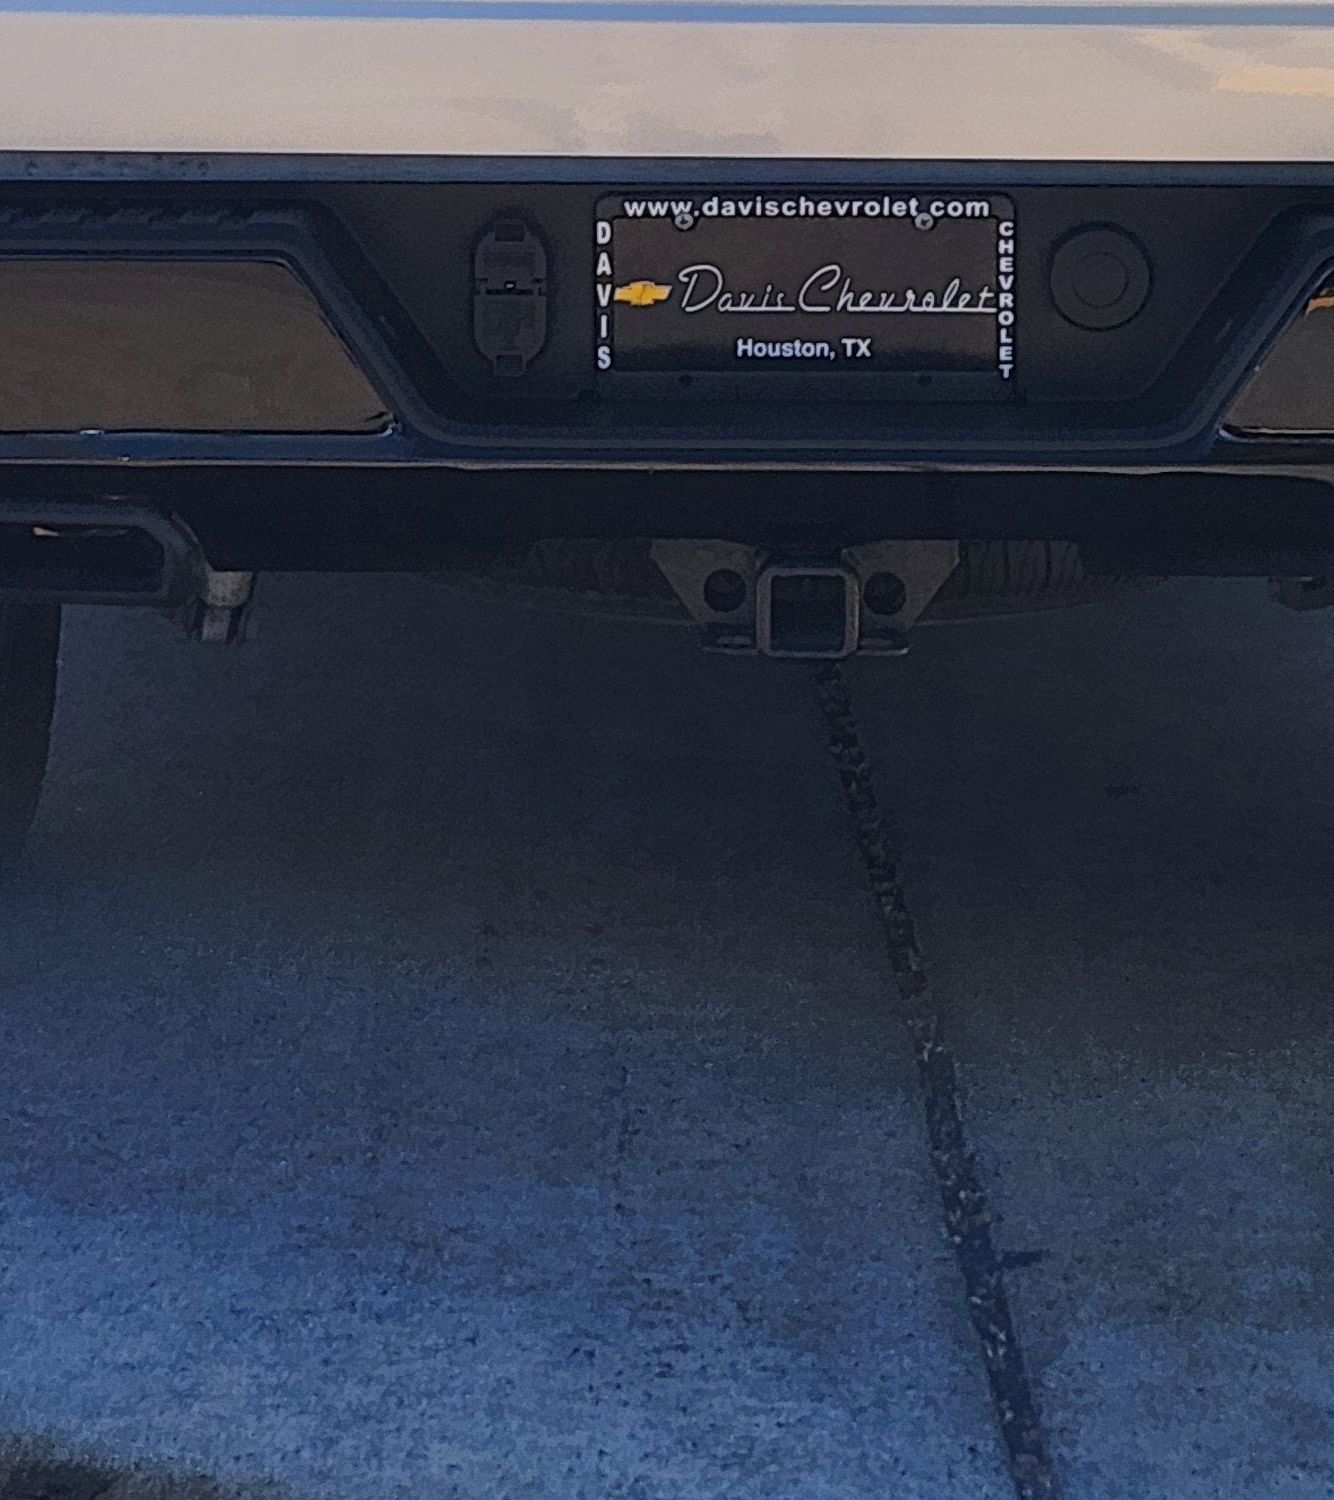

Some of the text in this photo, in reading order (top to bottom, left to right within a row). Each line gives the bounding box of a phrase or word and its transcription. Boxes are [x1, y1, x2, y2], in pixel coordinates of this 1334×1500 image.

[624, 196, 990, 218] www.davischevrolet.com
[596, 221, 612, 370] DAVIS
[677, 264, 997, 313] Davis Chevrolet
[998, 222, 1014, 380] CHEVROLET
[736, 338, 872, 361] Houston, TX
